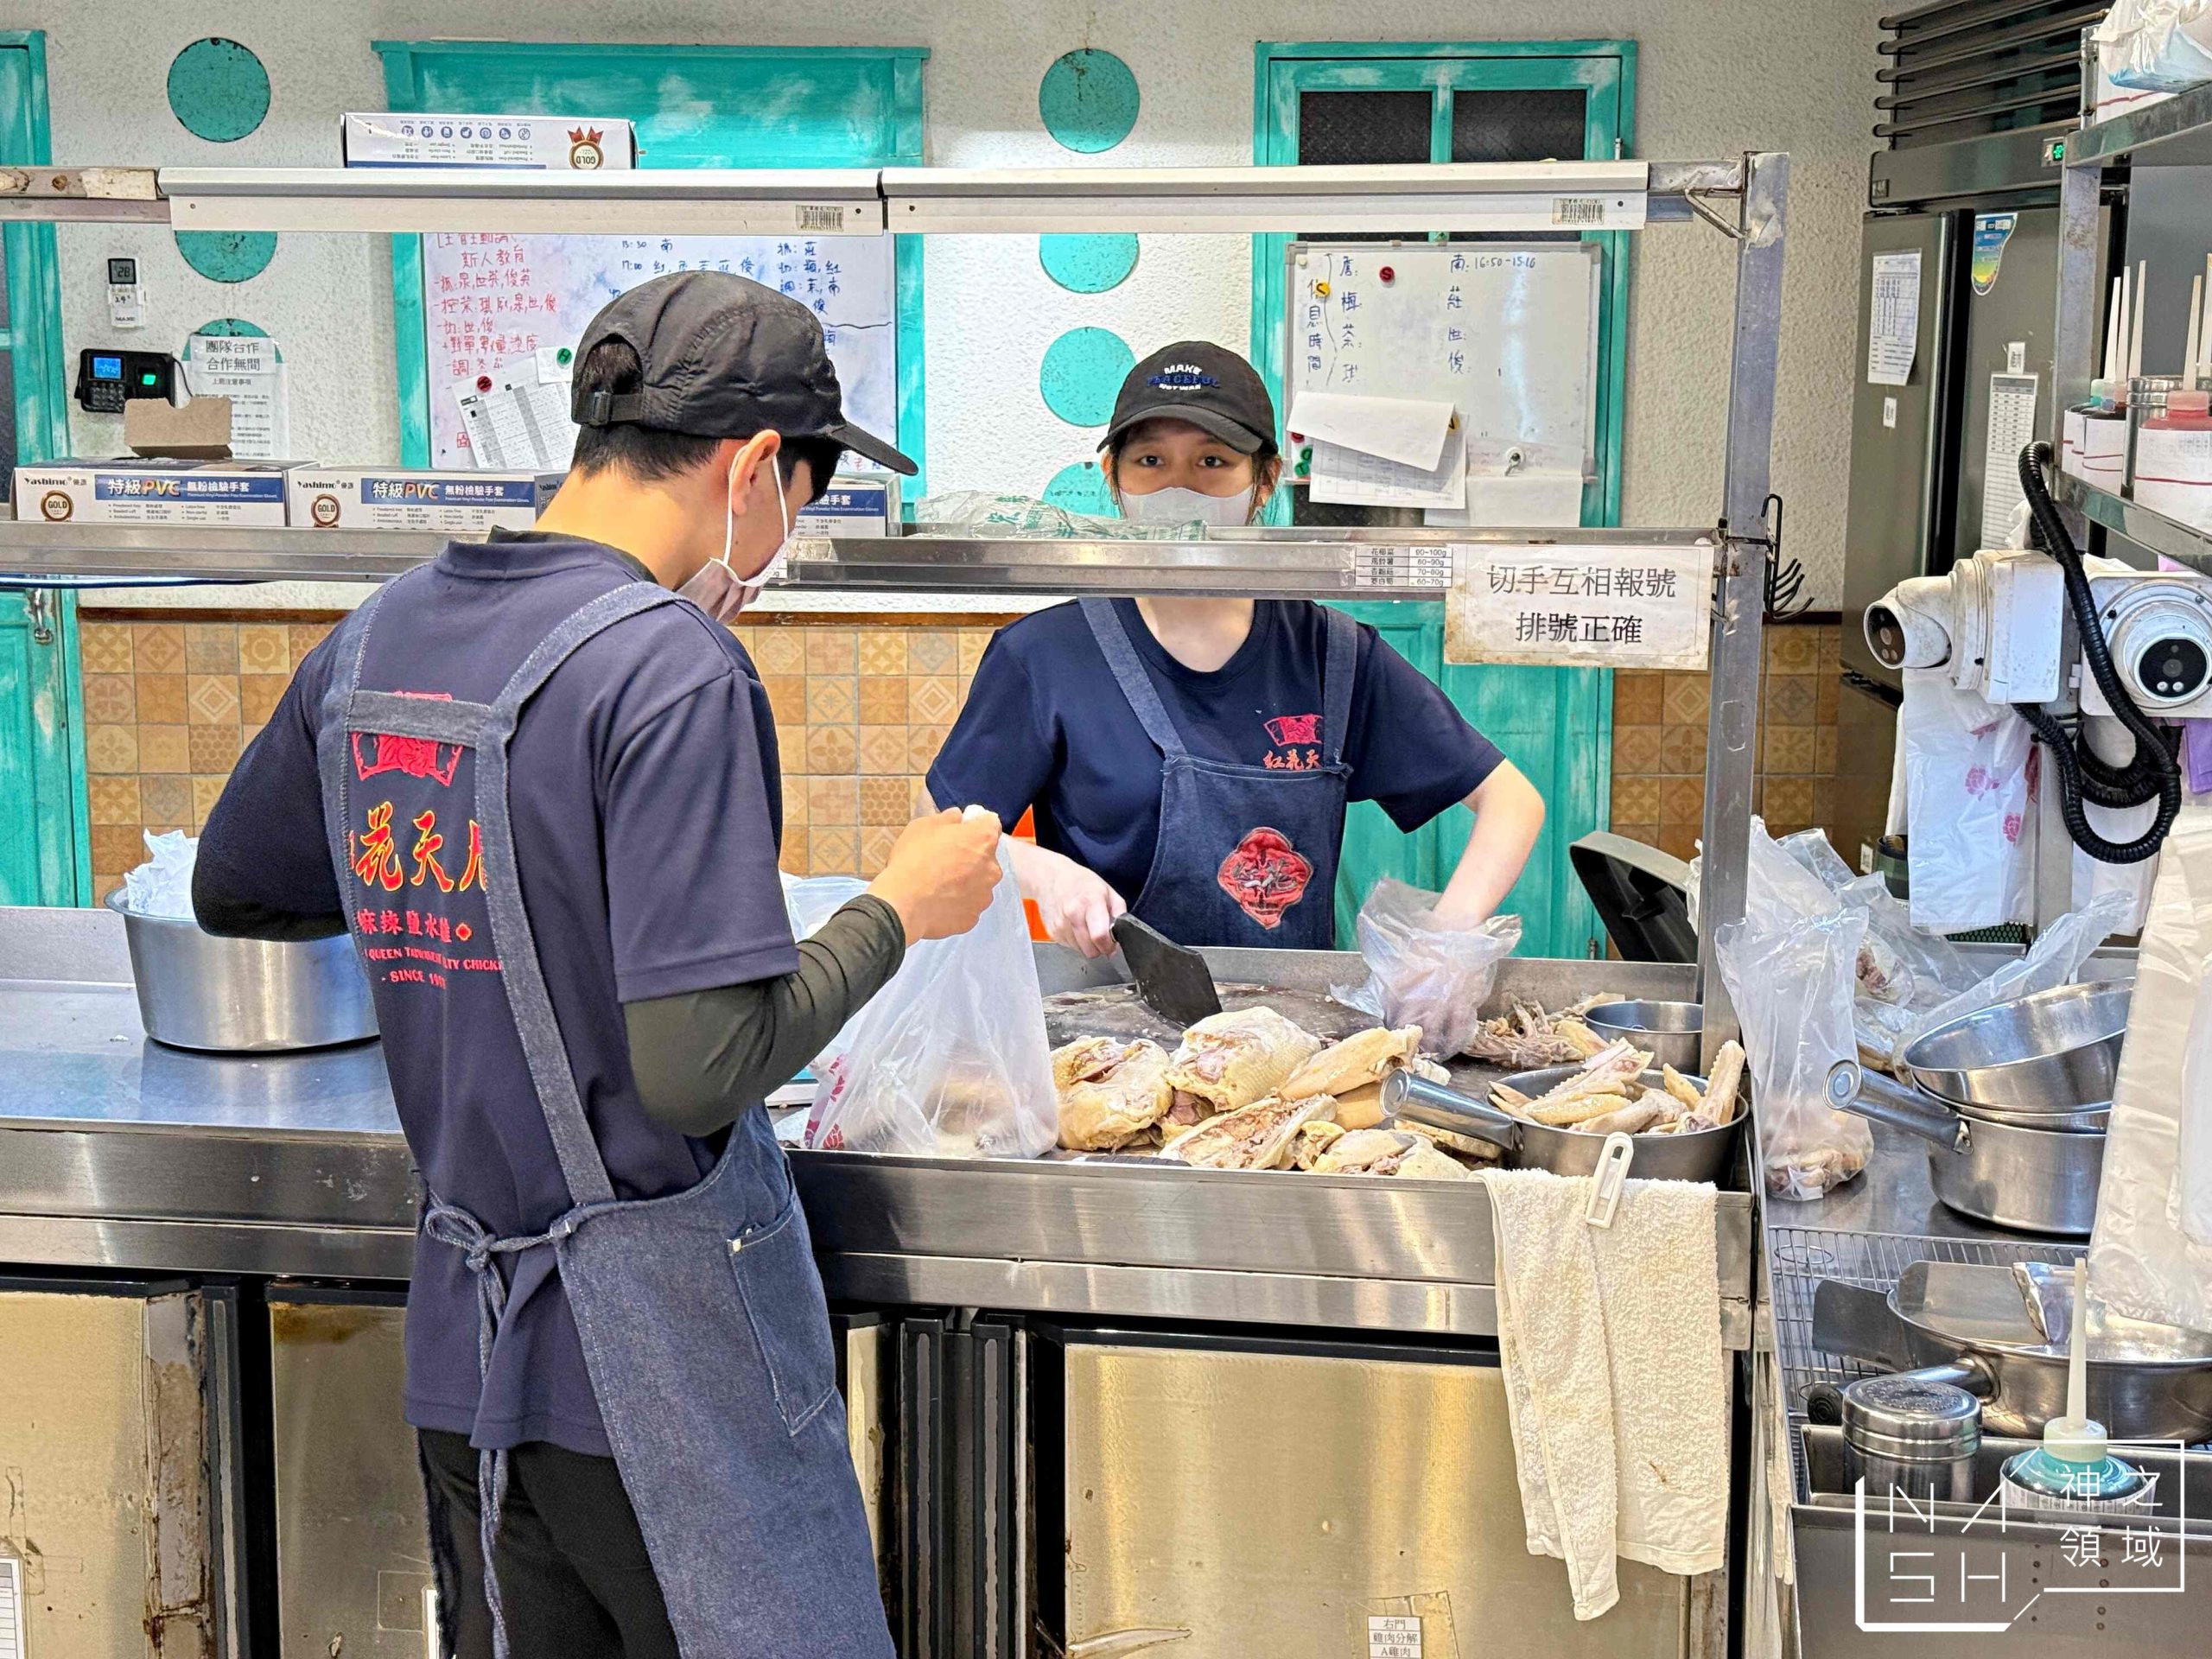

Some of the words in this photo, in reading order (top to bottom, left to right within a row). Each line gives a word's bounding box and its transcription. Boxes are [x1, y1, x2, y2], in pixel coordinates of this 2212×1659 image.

[575, 156, 596, 165] GOLD
[461, 244, 524, 269] 新人教育
[118, 266, 130, 277] 28
[206, 340, 259, 354] 團隊合作
[207, 357, 260, 372] 合作無間
[1164, 364, 1203, 375] MAKE
[107, 478, 181, 496] 特級PVC
[187, 480, 250, 493] 無粉檢驗手套
[372, 480, 440, 499] 特級PVC
[445, 485, 505, 497] 無粉檢驗手套
[48, 500, 67, 509] GOLD
[1486, 564, 1676, 598] 切手互相報號
[1516, 612, 1643, 645] 排號正確
[349, 801, 486, 893] 花天
[369, 949, 403, 961] QUEEN
[390, 969, 425, 983] SINCE
[1382, 1618, 1406, 1630] 右門
[1373, 1632, 1418, 1643] 雞肉分解
